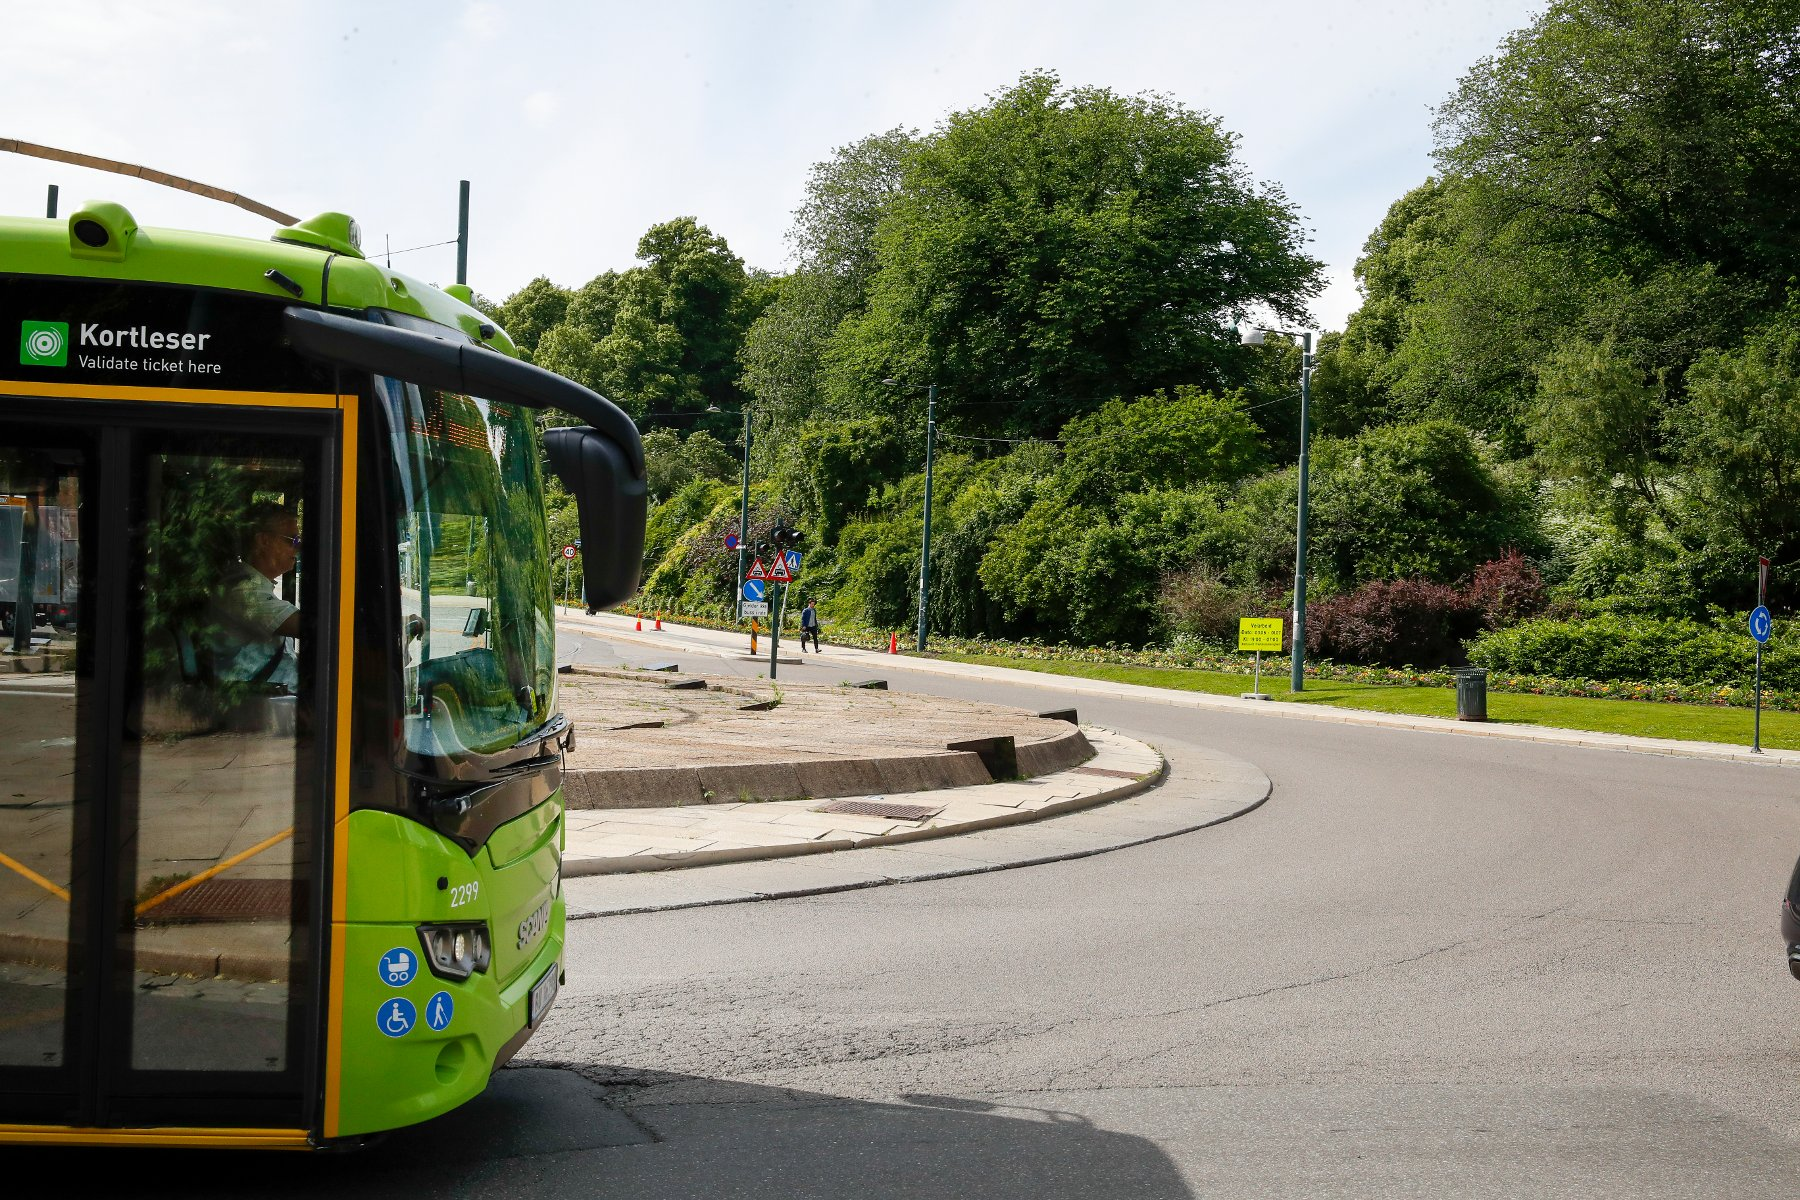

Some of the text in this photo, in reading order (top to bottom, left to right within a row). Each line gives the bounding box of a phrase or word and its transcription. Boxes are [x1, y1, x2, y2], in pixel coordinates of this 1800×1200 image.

[80, 323, 211, 350] Kortleser
[79, 355, 221, 374] Validate ticket here
[450, 881, 479, 908] 2299
